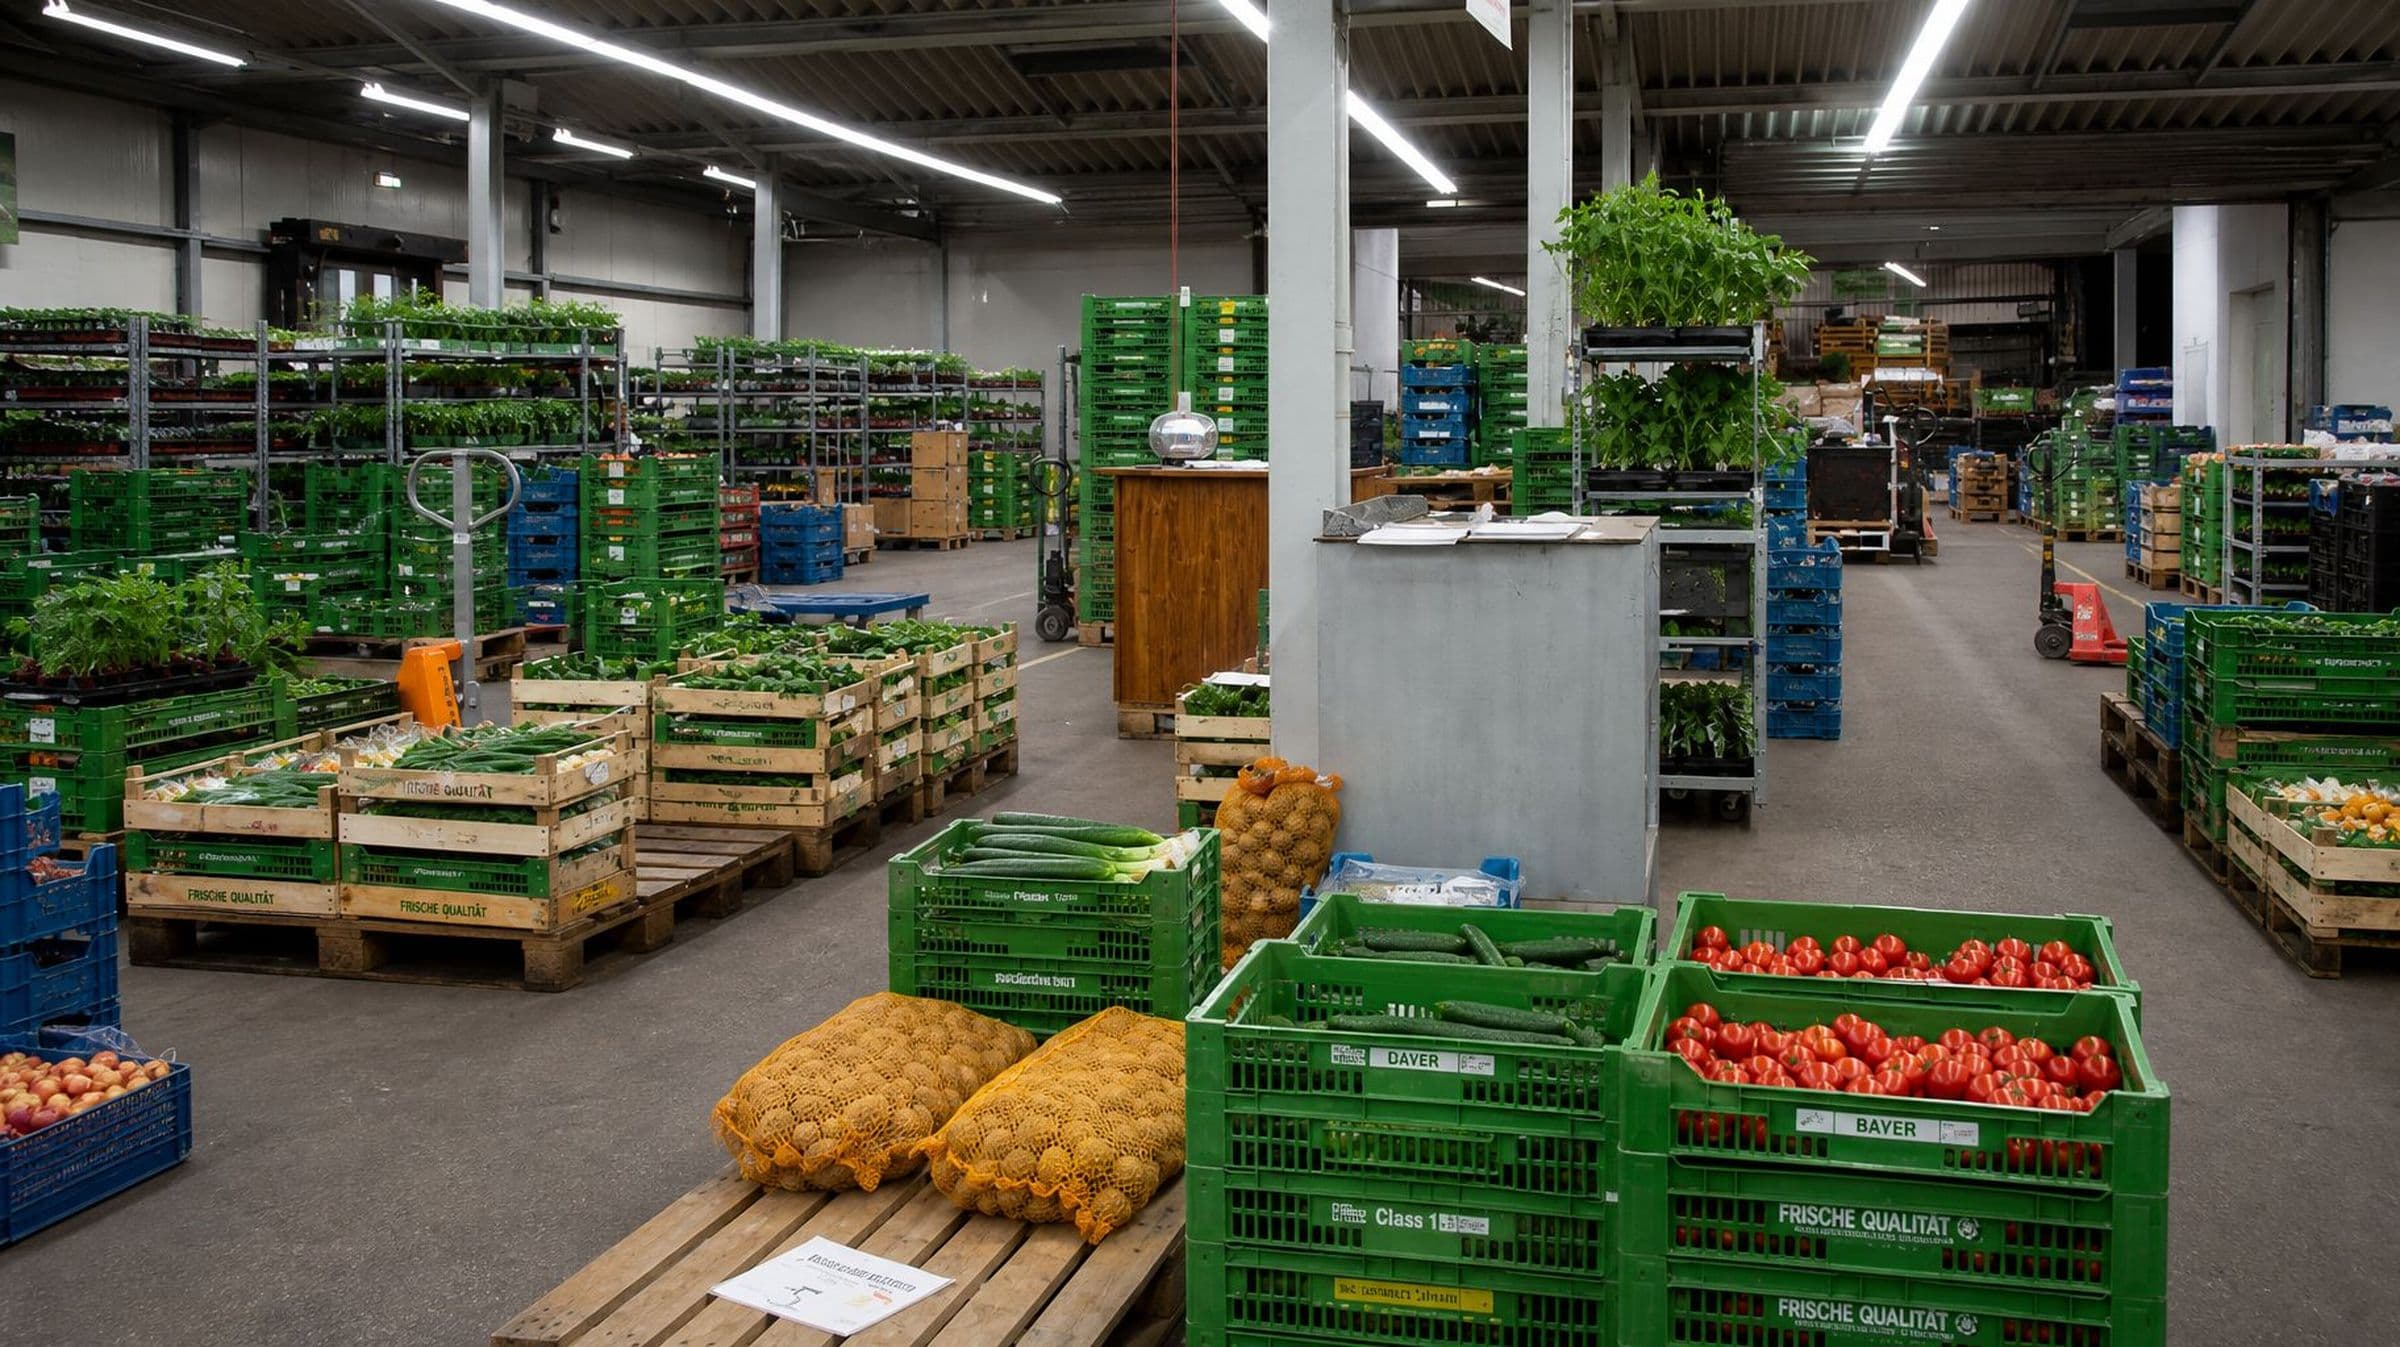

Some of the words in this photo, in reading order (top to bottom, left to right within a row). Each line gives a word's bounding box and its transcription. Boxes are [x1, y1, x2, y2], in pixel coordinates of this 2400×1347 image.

[1375, 1207, 1423, 1229] Class
[1428, 1212, 1437, 1230] 1
[1779, 1203, 1855, 1228] FRISCHE
[1778, 1299, 1854, 1323] FRISCHE
